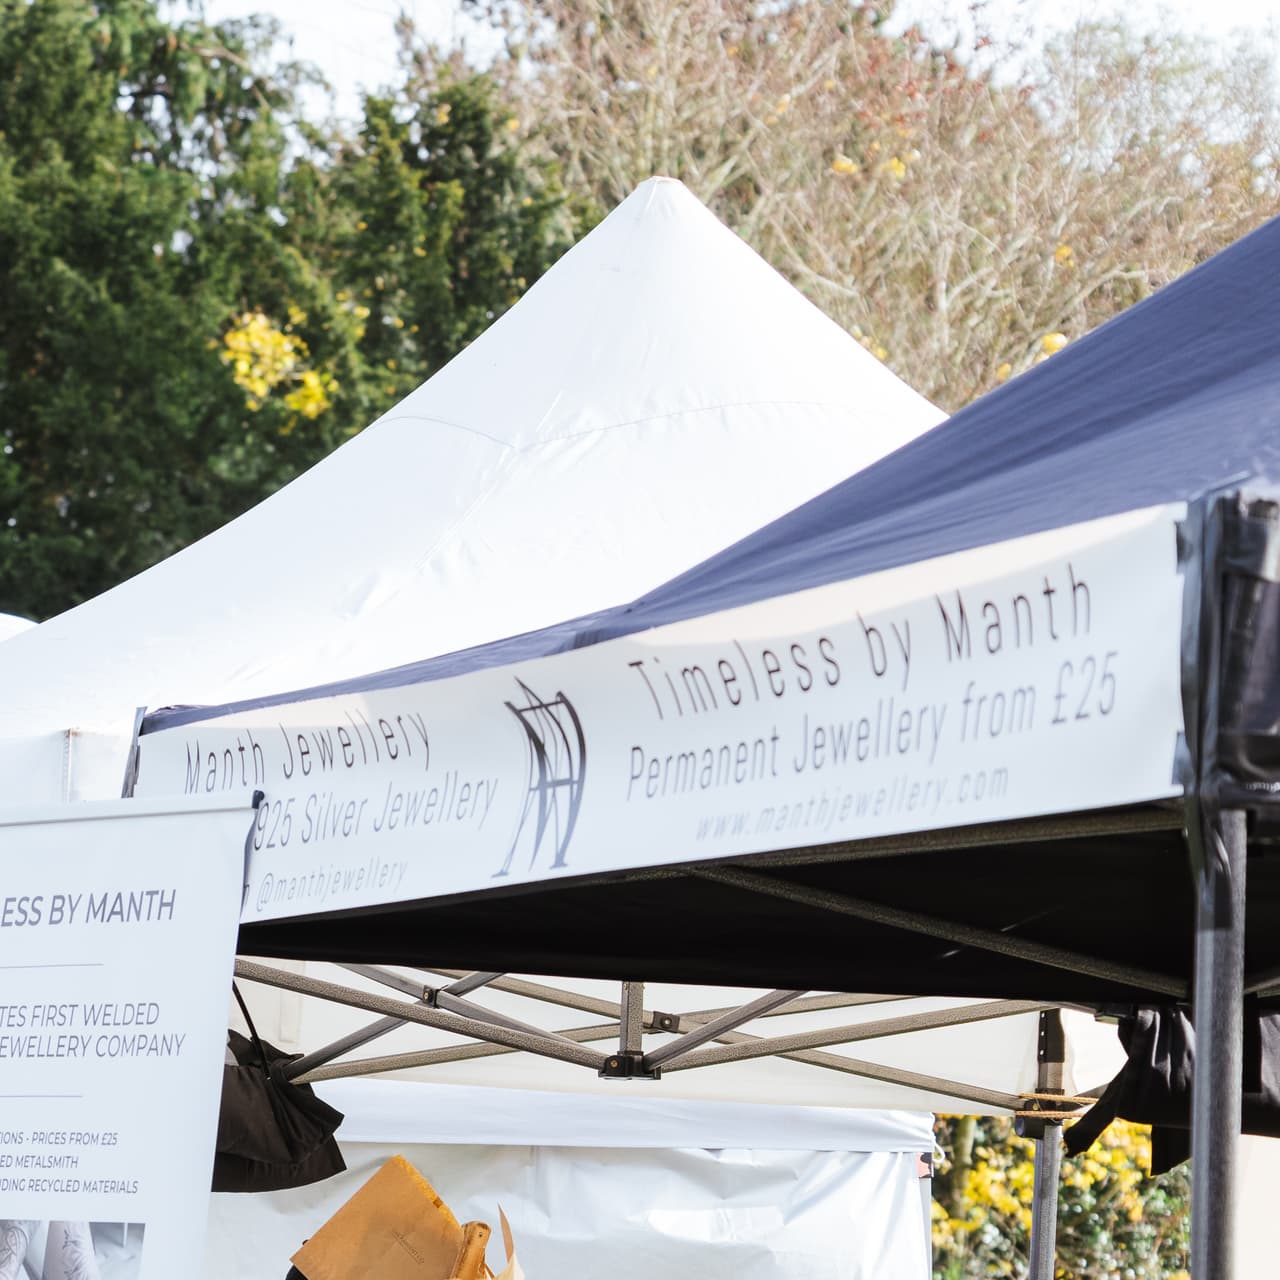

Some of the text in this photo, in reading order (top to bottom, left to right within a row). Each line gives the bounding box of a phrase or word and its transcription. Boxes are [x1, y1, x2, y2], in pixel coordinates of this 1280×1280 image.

[629, 562, 1092, 720] Timeless by Manth
[627, 651, 1119, 801] Permanent Jewellery from £25
[185, 707, 432, 795] Manth Jewellery
[253, 770, 499, 851] 925 Silver Jewellery
[695, 765, 1009, 841] www.manthjewellery.com
[48, 893, 82, 925] BY
[85, 888, 176, 923] MANTH
[255, 858, 408, 912] @manthjewellery
[30, 1003, 79, 1026] FIRST
[83, 1002, 159, 1026] WELDED
[95, 1033, 185, 1057] COMPANY
[31, 1131, 66, 1144] PRICES
[68, 1131, 99, 1145] FROM
[100, 1132, 118, 1145] £25
[14, 1154, 78, 1168] METALSMITH
[27, 1178, 80, 1192] RECYCLED
[82, 1179, 138, 1193] MATERIALS
